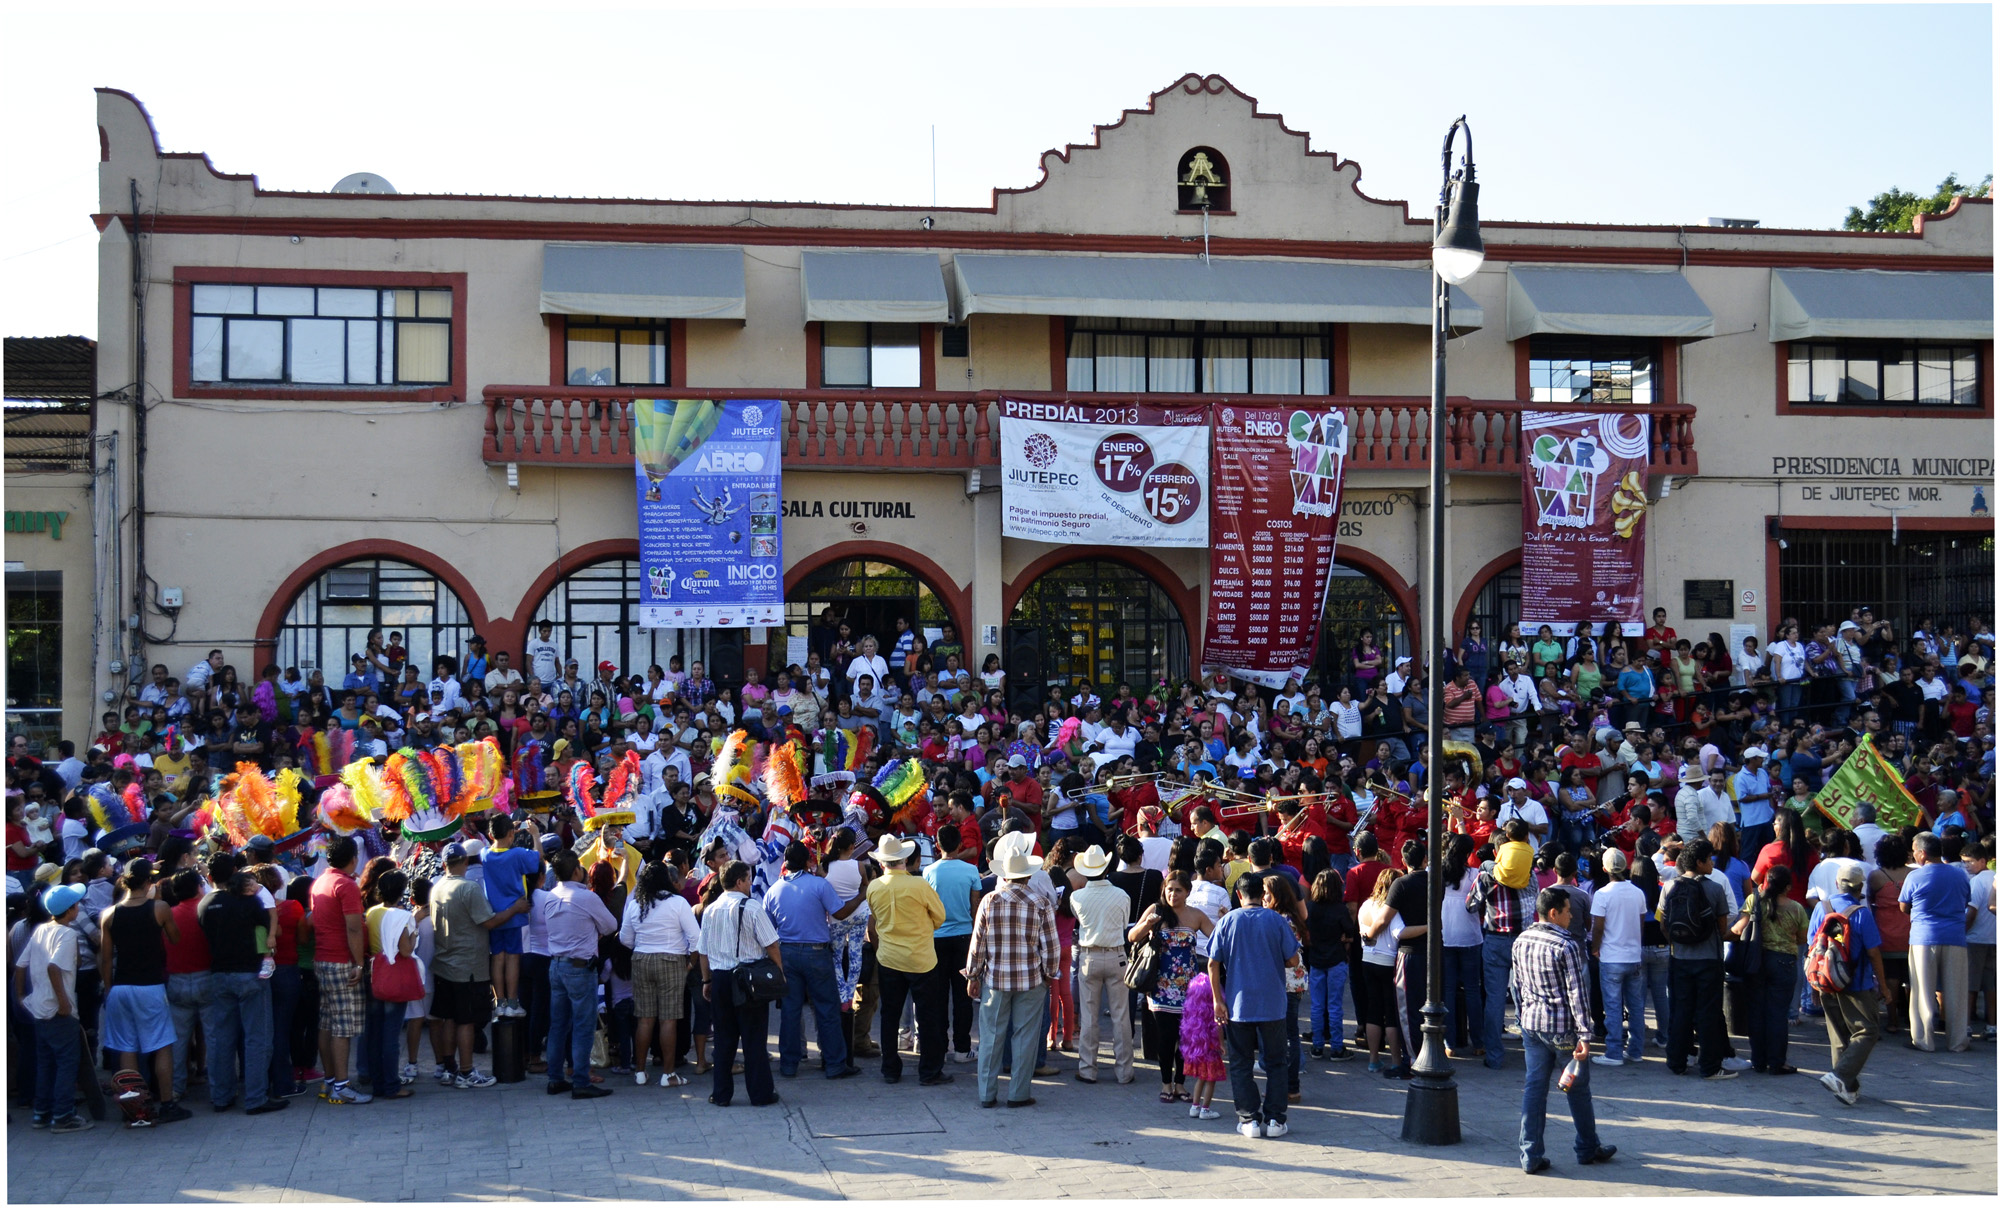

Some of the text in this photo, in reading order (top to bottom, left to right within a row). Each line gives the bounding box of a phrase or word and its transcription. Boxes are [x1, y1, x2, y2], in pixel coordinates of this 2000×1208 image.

[1005, 401, 1138, 424] PREDIAL 2013
[1245, 411, 1281, 420] Del 21
[731, 427, 775, 436] JIUTEPEC
[1245, 420, 1282, 436] ENERO
[1103, 442, 1143, 453] ENERO
[1099, 454, 1141, 481] 17%
[1772, 457, 1901, 475] PRESIDENCIA
[1009, 468, 1079, 486] JIUTEPEC
[1149, 474, 1195, 484] FEBRERO
[1802, 486, 1942, 501] DE JIUTEPEC MOR.
[1146, 488, 1190, 518] 15%
[782, 500, 916, 518] SALA CULTURAL
[1009, 505, 1030, 515] Pagar
[1040, 510, 1077, 521] impuesto
[1079, 512, 1109, 521] predial,
[1101, 492, 1153, 529] DE DESCUENTO
[1020, 516, 1060, 527] patrimonio
[1061, 520, 1091, 530] Seguro
[1266, 520, 1293, 528] COSTOS
[1009, 525, 1081, 538] www.jiutepec.gob.mx
[1223, 532, 1237, 540] GIRO
[1525, 531, 1540, 541] Del
[1555, 532, 1562, 541] al
[1564, 532, 1576, 541] 21
[1578, 532, 1586, 541] de
[1589, 533, 1609, 542] Enero
[1215, 543, 1304, 553] ALIMENTOS $500.00 $216.00
[1252, 555, 1273, 563] $500.00
[1283, 556, 1304, 564] $216.00
[728, 564, 777, 580] INICIO
[1218, 567, 1303, 576] DULCES $400.00 $216.00
[681, 577, 720, 590] Corona
[1213, 578, 1244, 587] ARTESANÍAS
[1252, 579, 1272, 587] $400.00
[1212, 590, 1300, 599] NOVEDADES $400.00 $96.00
[1219, 602, 1236, 610] ROPA
[1250, 602, 1270, 610] $400.00
[1217, 613, 1236, 621] LENTES
[1280, 614, 1300, 622] $216.00
[1247, 637, 1268, 645] $400.00
[1279, 637, 1297, 645] $96.00
